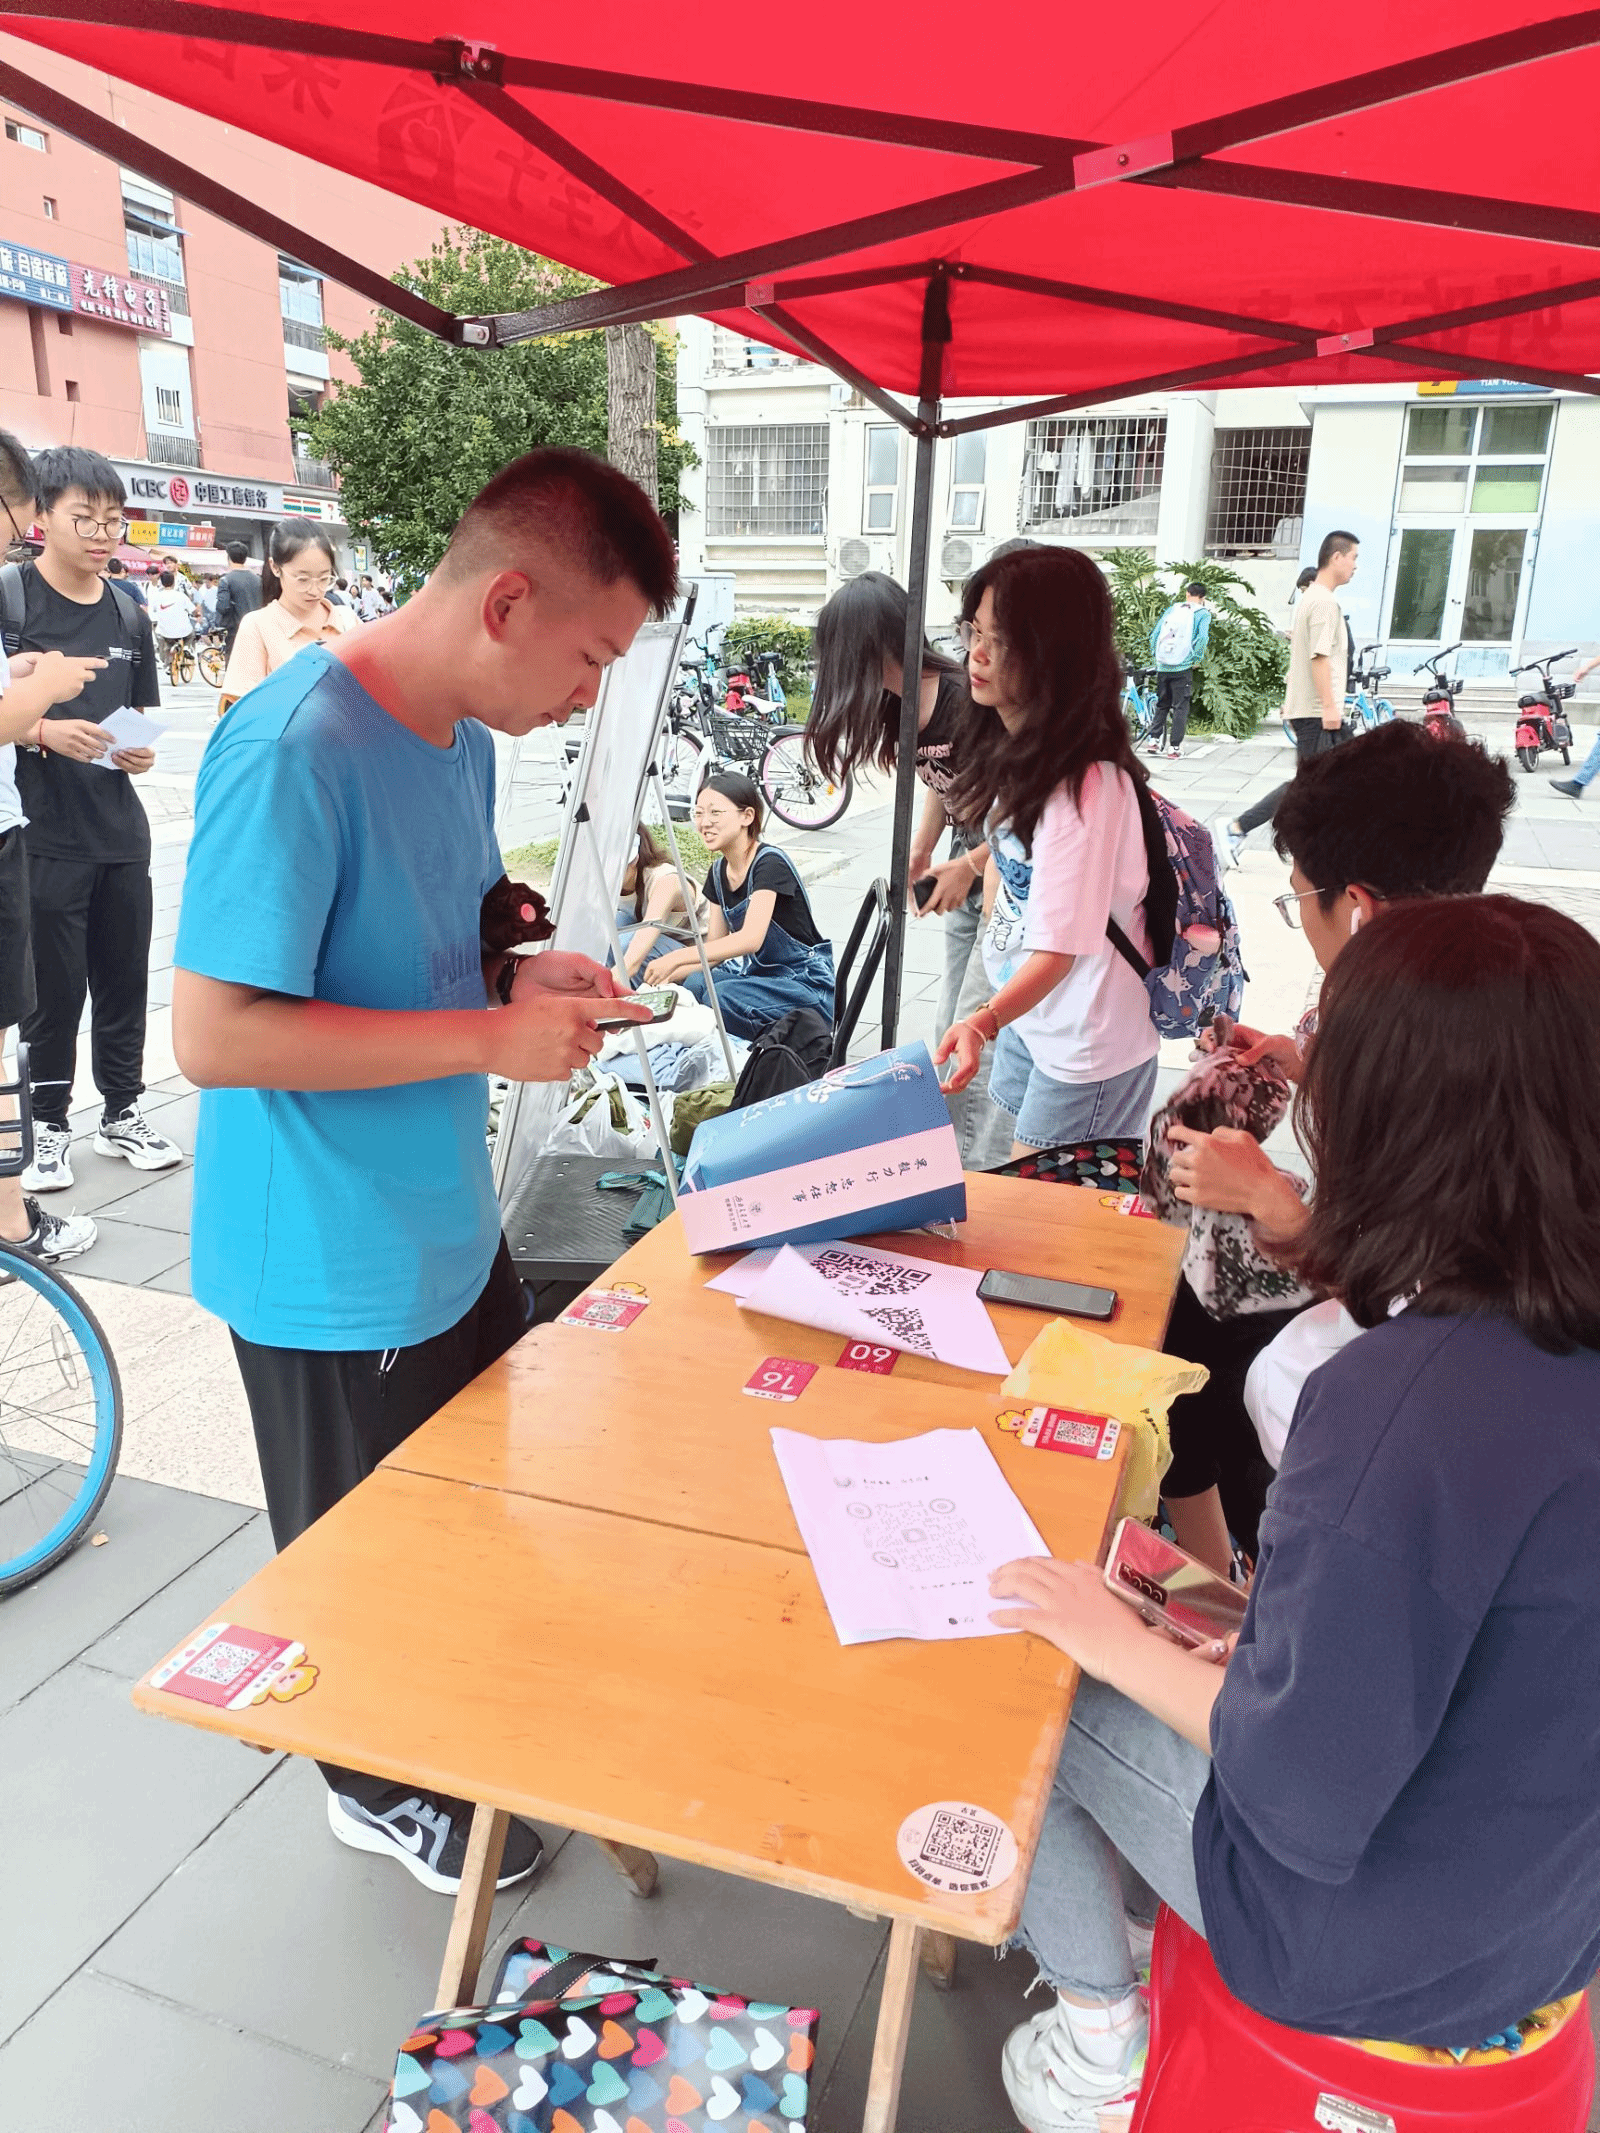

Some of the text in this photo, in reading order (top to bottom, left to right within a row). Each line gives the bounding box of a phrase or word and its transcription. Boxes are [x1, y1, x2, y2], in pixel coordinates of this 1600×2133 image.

[82, 270, 156, 316] 先锋电子
[131, 477, 168, 500] ICBC
[195, 481, 268, 509] 中国工商银行
[792, 1157, 929, 1203] 果毅力行 忠恕任事
[760, 1371, 795, 1391] 16
